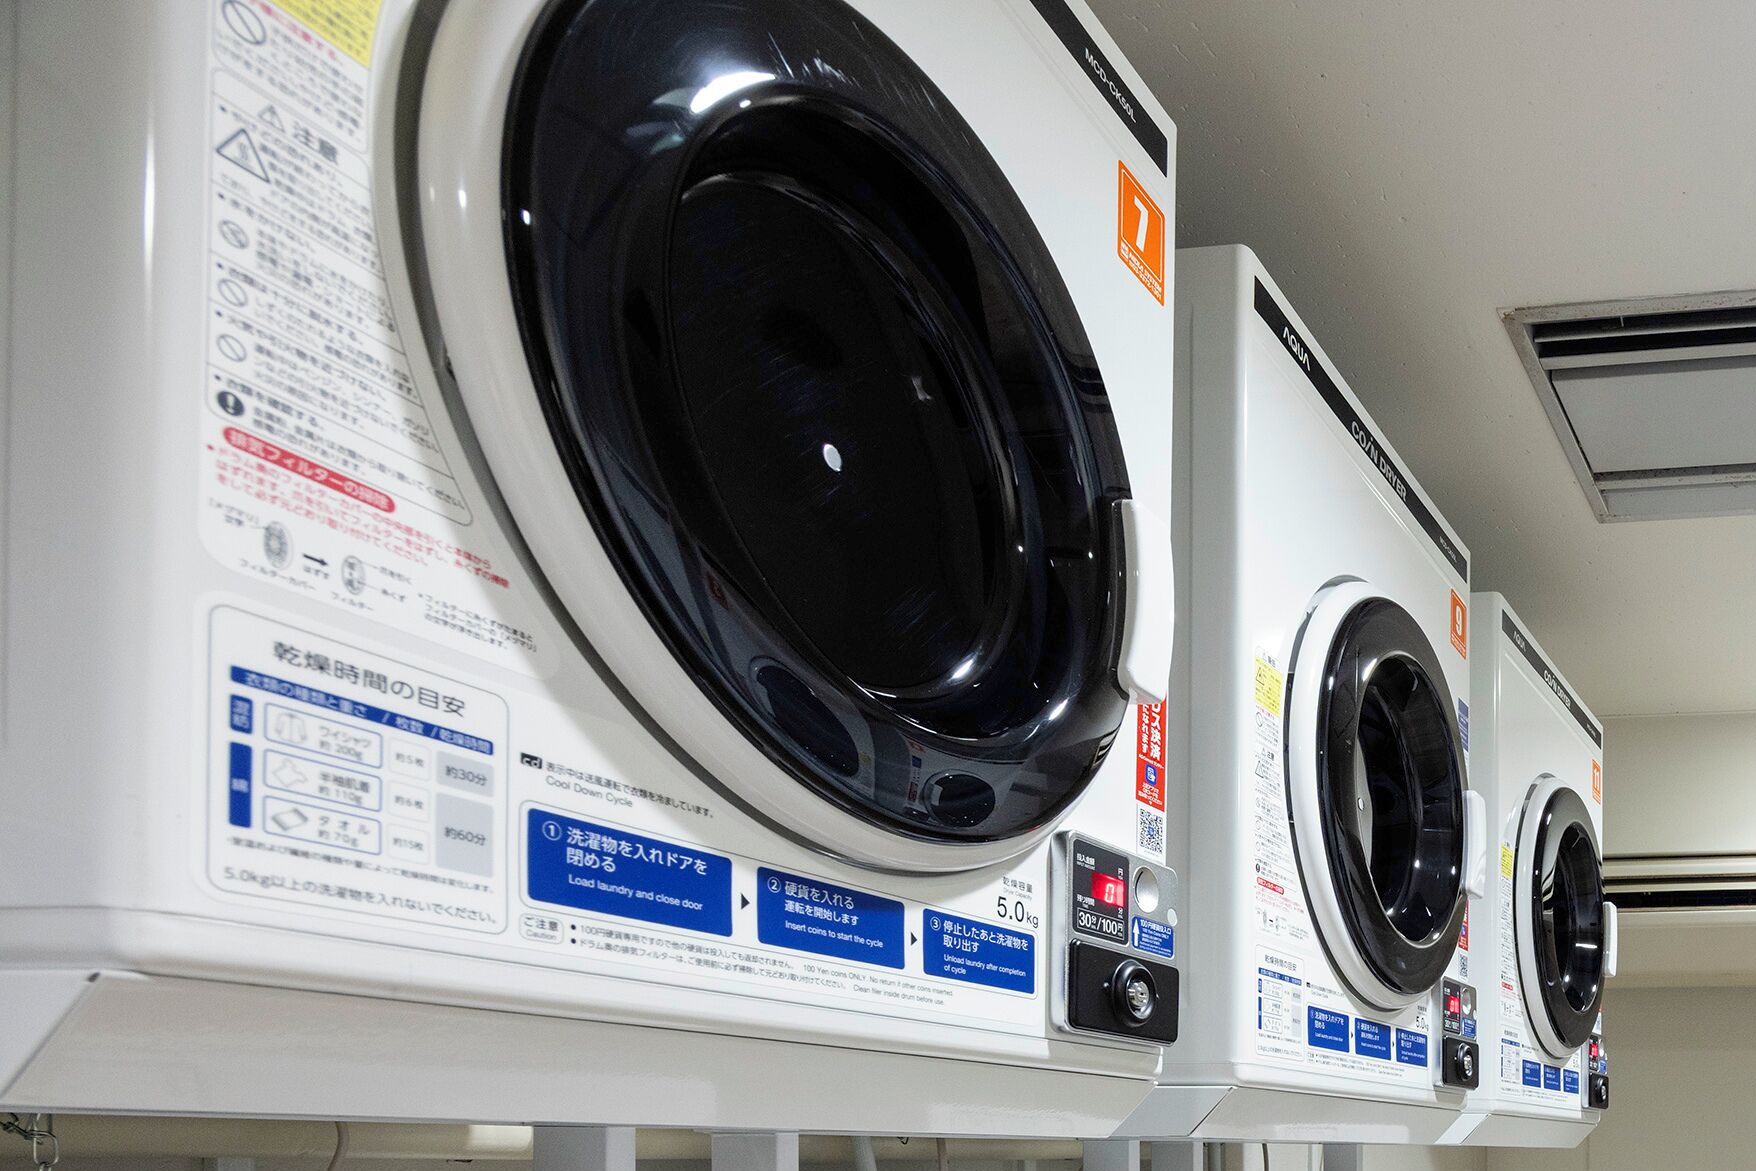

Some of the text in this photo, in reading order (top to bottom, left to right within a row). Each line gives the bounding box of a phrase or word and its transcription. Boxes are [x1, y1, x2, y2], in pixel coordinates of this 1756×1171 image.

[1085, 47, 1137, 123] MCD-CK50L
[1134, 195, 1149, 253] 7
[1283, 326, 1312, 372] AQUA
[1378, 454, 1408, 502] DRYER
[1454, 608, 1463, 636] 9
[272, 640, 467, 718] 乾燥時間の目安
[445, 764, 488, 786] 約30分
[1593, 768, 1600, 789] 11
[545, 775, 634, 808] Cool Down Cycle
[444, 826, 487, 847] 約60分
[566, 825, 708, 876] 洗濯物を入れドアを
[566, 848, 617, 873] 閉める
[568, 874, 704, 912] Load laundry and close door
[784, 880, 856, 911] 硬貨を入れる
[523, 916, 559, 933] ご注意
[784, 900, 860, 927] 運転を開始します
[996, 894, 1040, 929] 5.0kg
[784, 920, 884, 949] Insert coins to start the cycle
[943, 919, 1030, 952] 停止したあと洗濯物を
[943, 936, 981, 954] 取り出す
[943, 953, 1026, 978] Unload laundry after completion
[943, 963, 967, 976] of cycle
